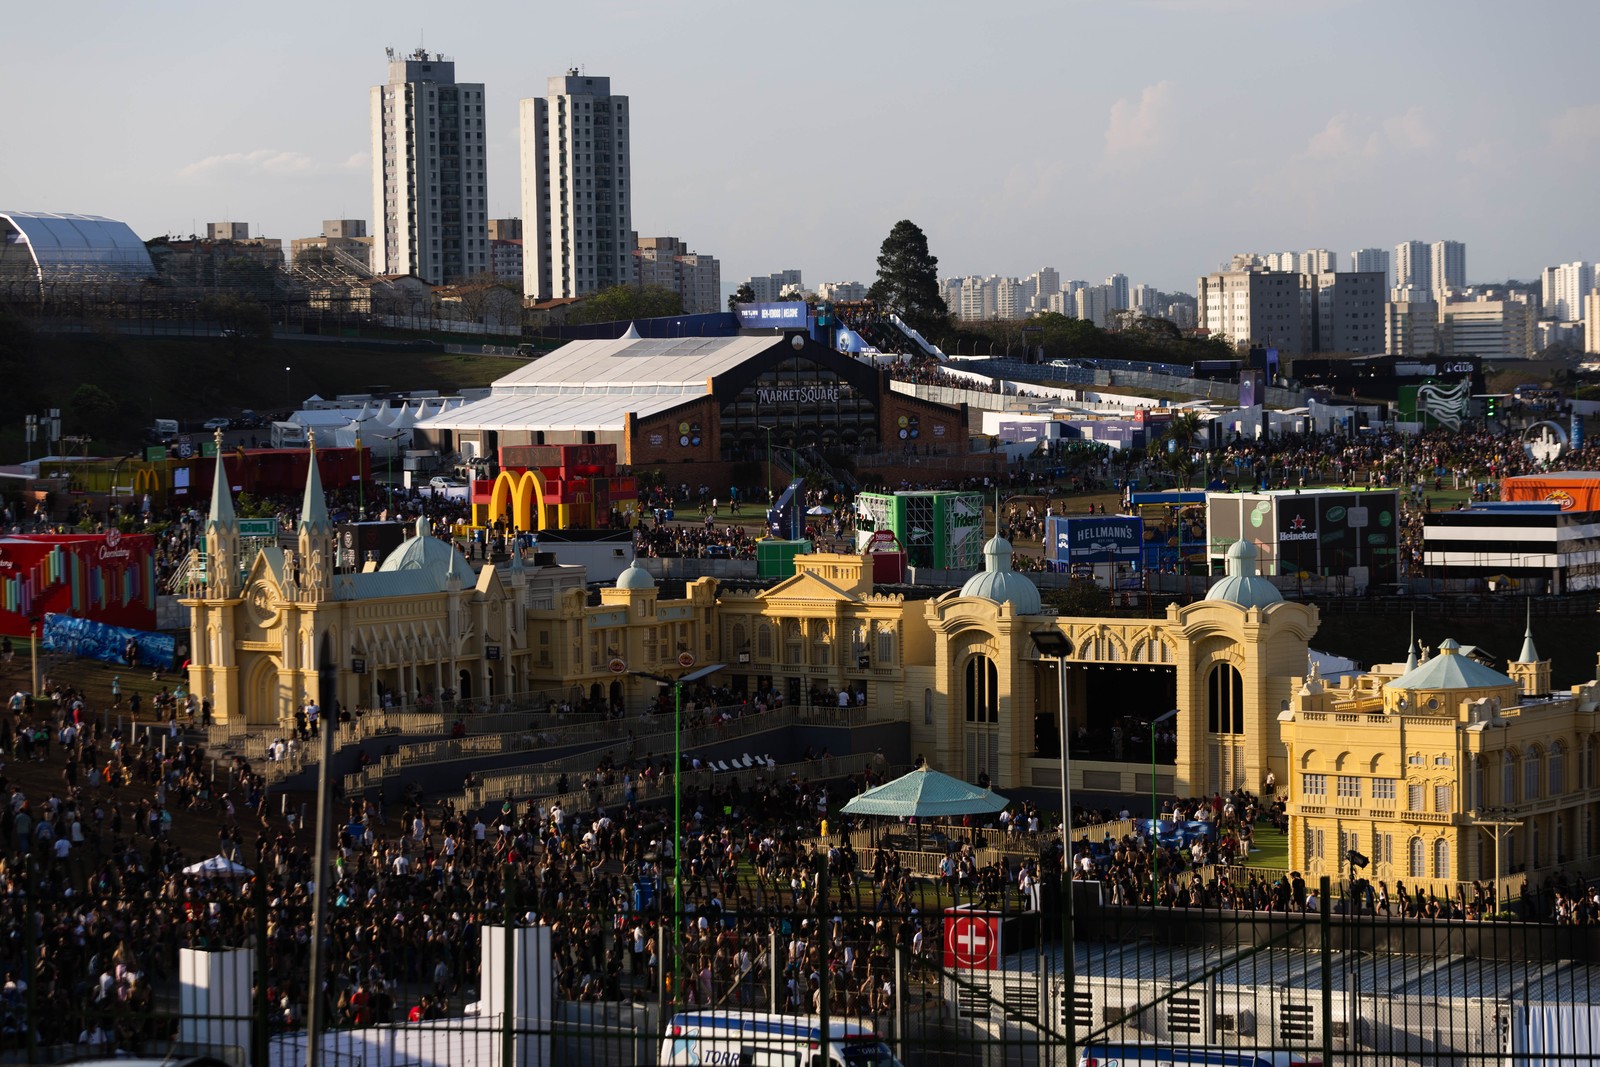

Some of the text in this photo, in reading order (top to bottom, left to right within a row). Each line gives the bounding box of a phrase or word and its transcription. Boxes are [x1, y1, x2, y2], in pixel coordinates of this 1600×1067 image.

[180, 443, 191, 455] 85
[953, 511, 981, 528] Trident
[1077, 525, 1134, 541] HELLMANN'S
[1279, 531, 1318, 541] Heineken
